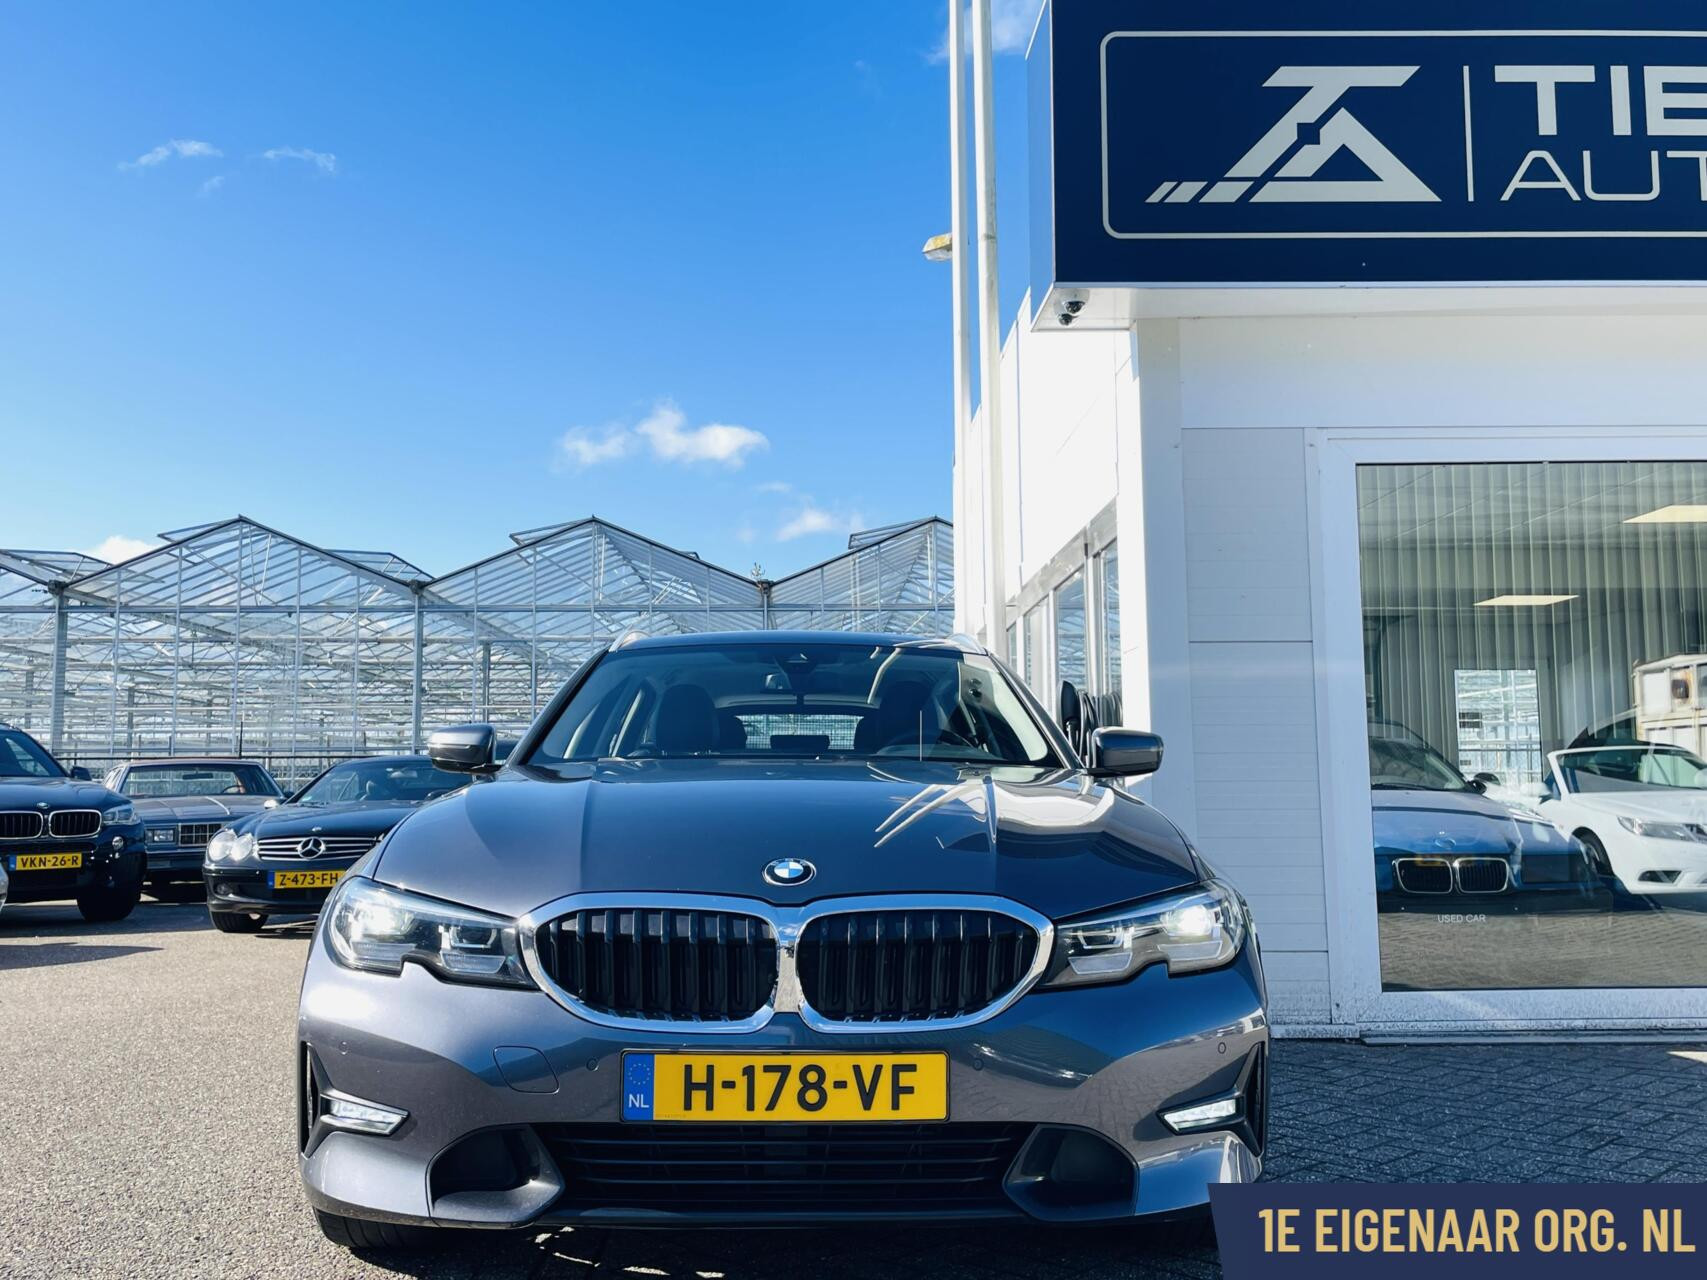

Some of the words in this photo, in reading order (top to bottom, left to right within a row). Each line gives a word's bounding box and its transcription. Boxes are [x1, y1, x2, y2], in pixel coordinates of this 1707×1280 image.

[1500, 150, 1707, 201] AUT
[21, 855, 79, 868] VKN-26-R
[279, 872, 338, 886] Z-473-FH
[1437, 914, 1463, 923] USED
[1465, 914, 1487, 923] CAR
[683, 1064, 917, 1112] H-178-VF
[628, 1093, 650, 1109] NL
